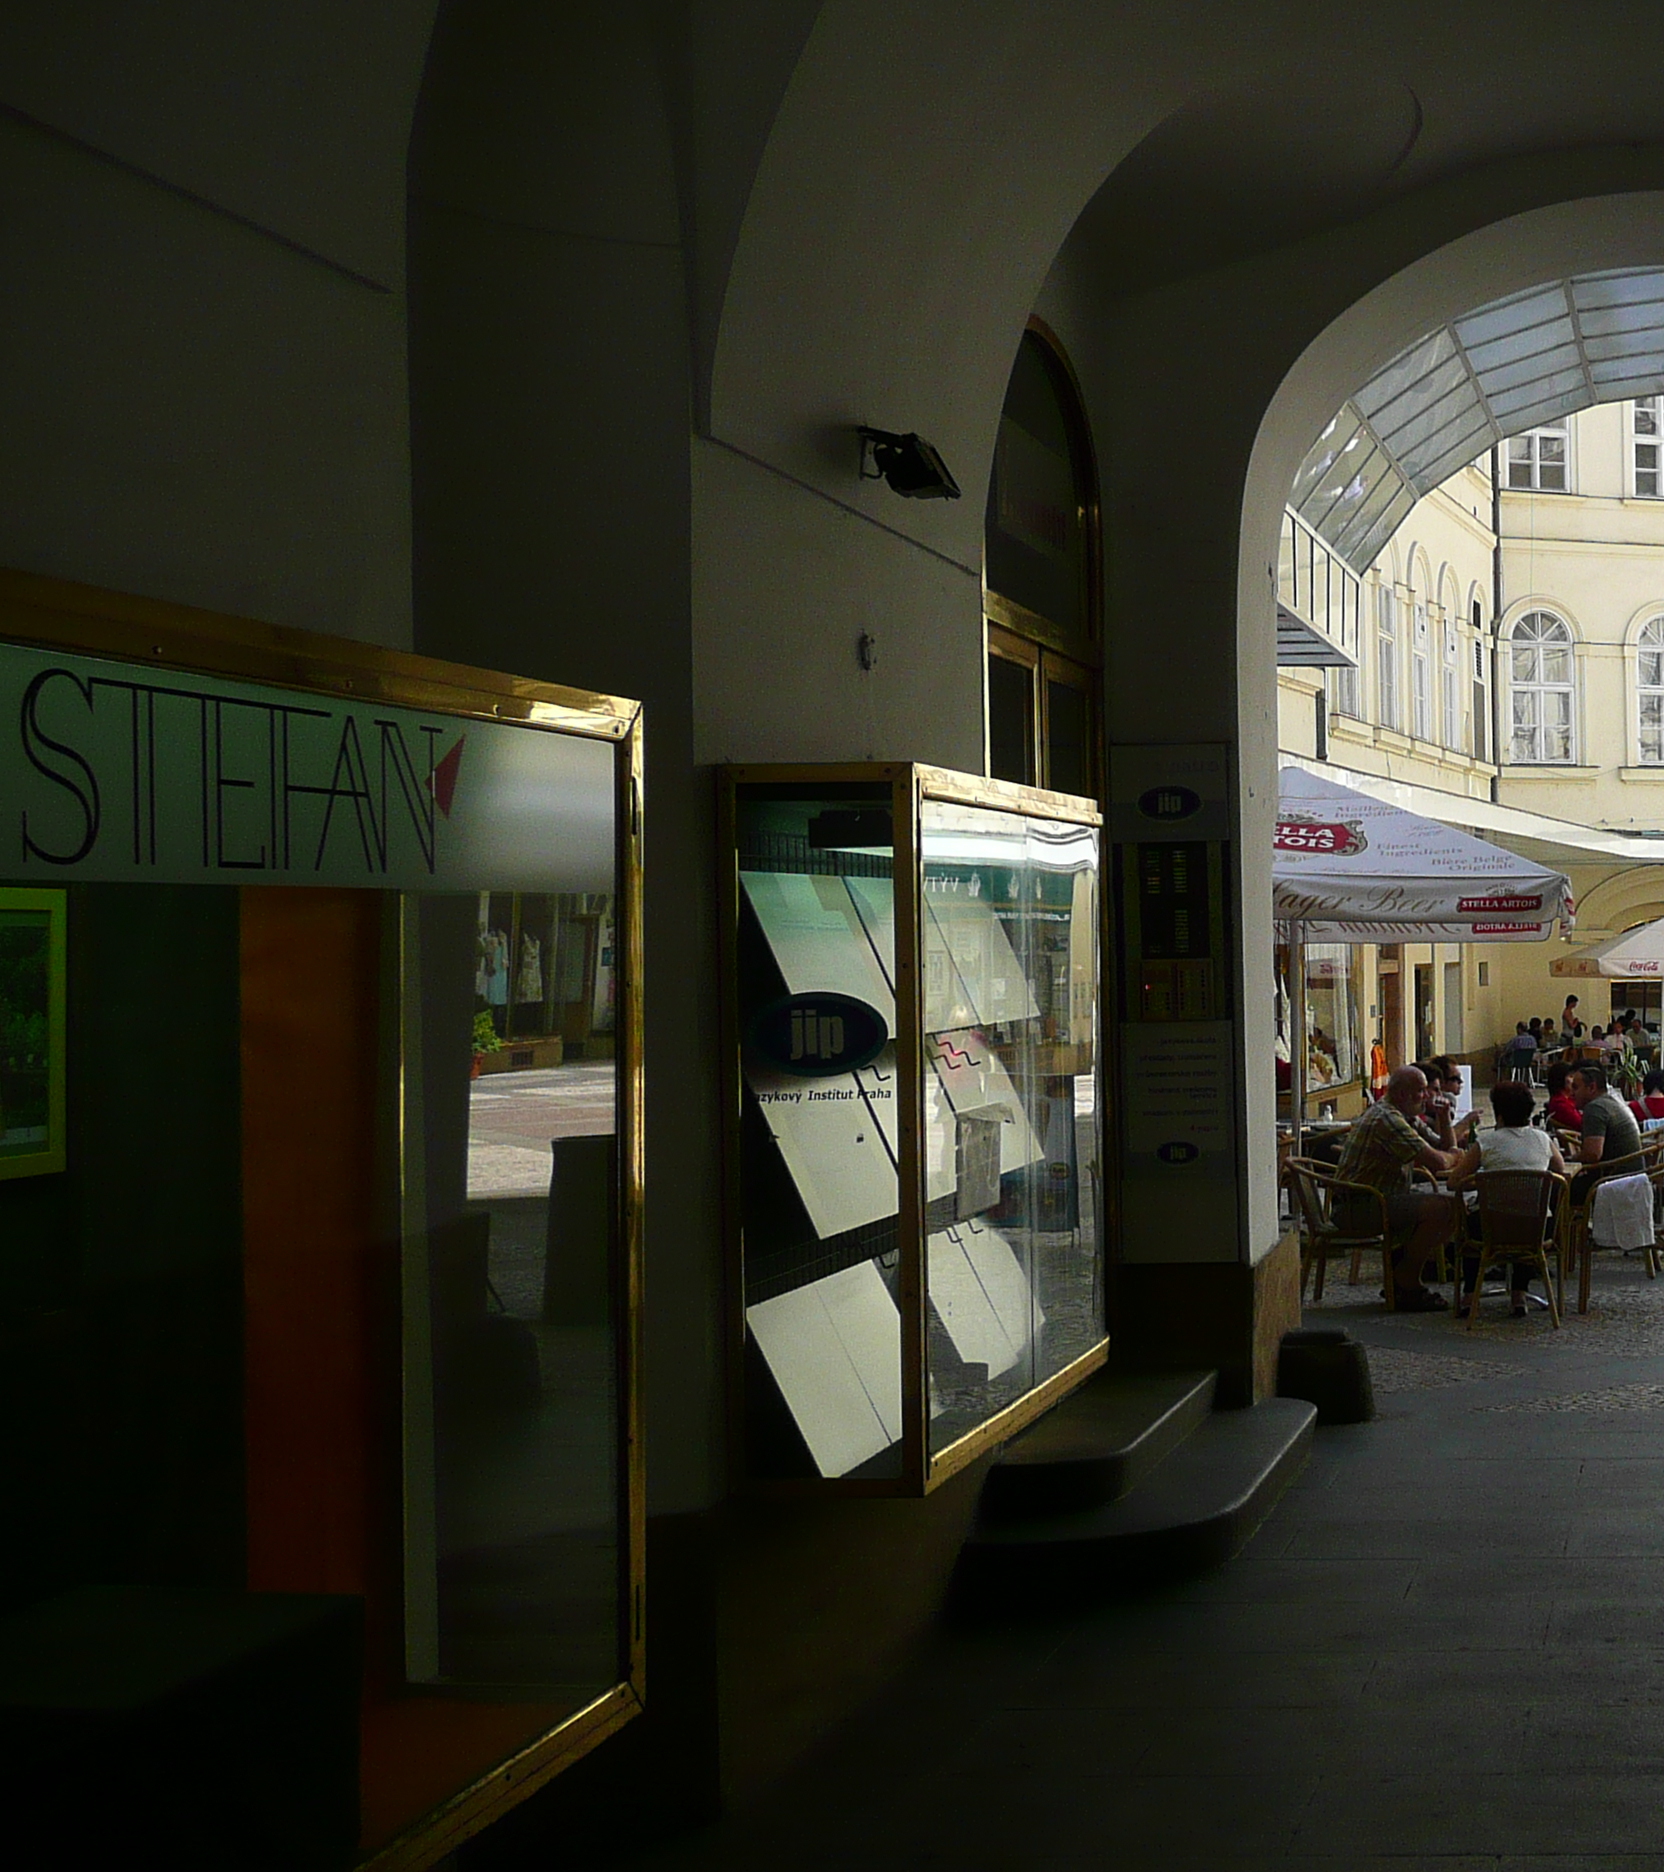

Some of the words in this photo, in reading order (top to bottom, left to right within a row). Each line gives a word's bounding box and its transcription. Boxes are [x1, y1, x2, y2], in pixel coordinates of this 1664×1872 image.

[1359, 883, 1446, 913] Beer
[1462, 899, 1499, 909] STELLA
[1499, 898, 1538, 909] ARTOIS
[789, 1008, 845, 1062] jip
[755, 1090, 802, 1104] azykový
[808, 1089, 853, 1101] Institut
[857, 1088, 891, 1100] Praha
